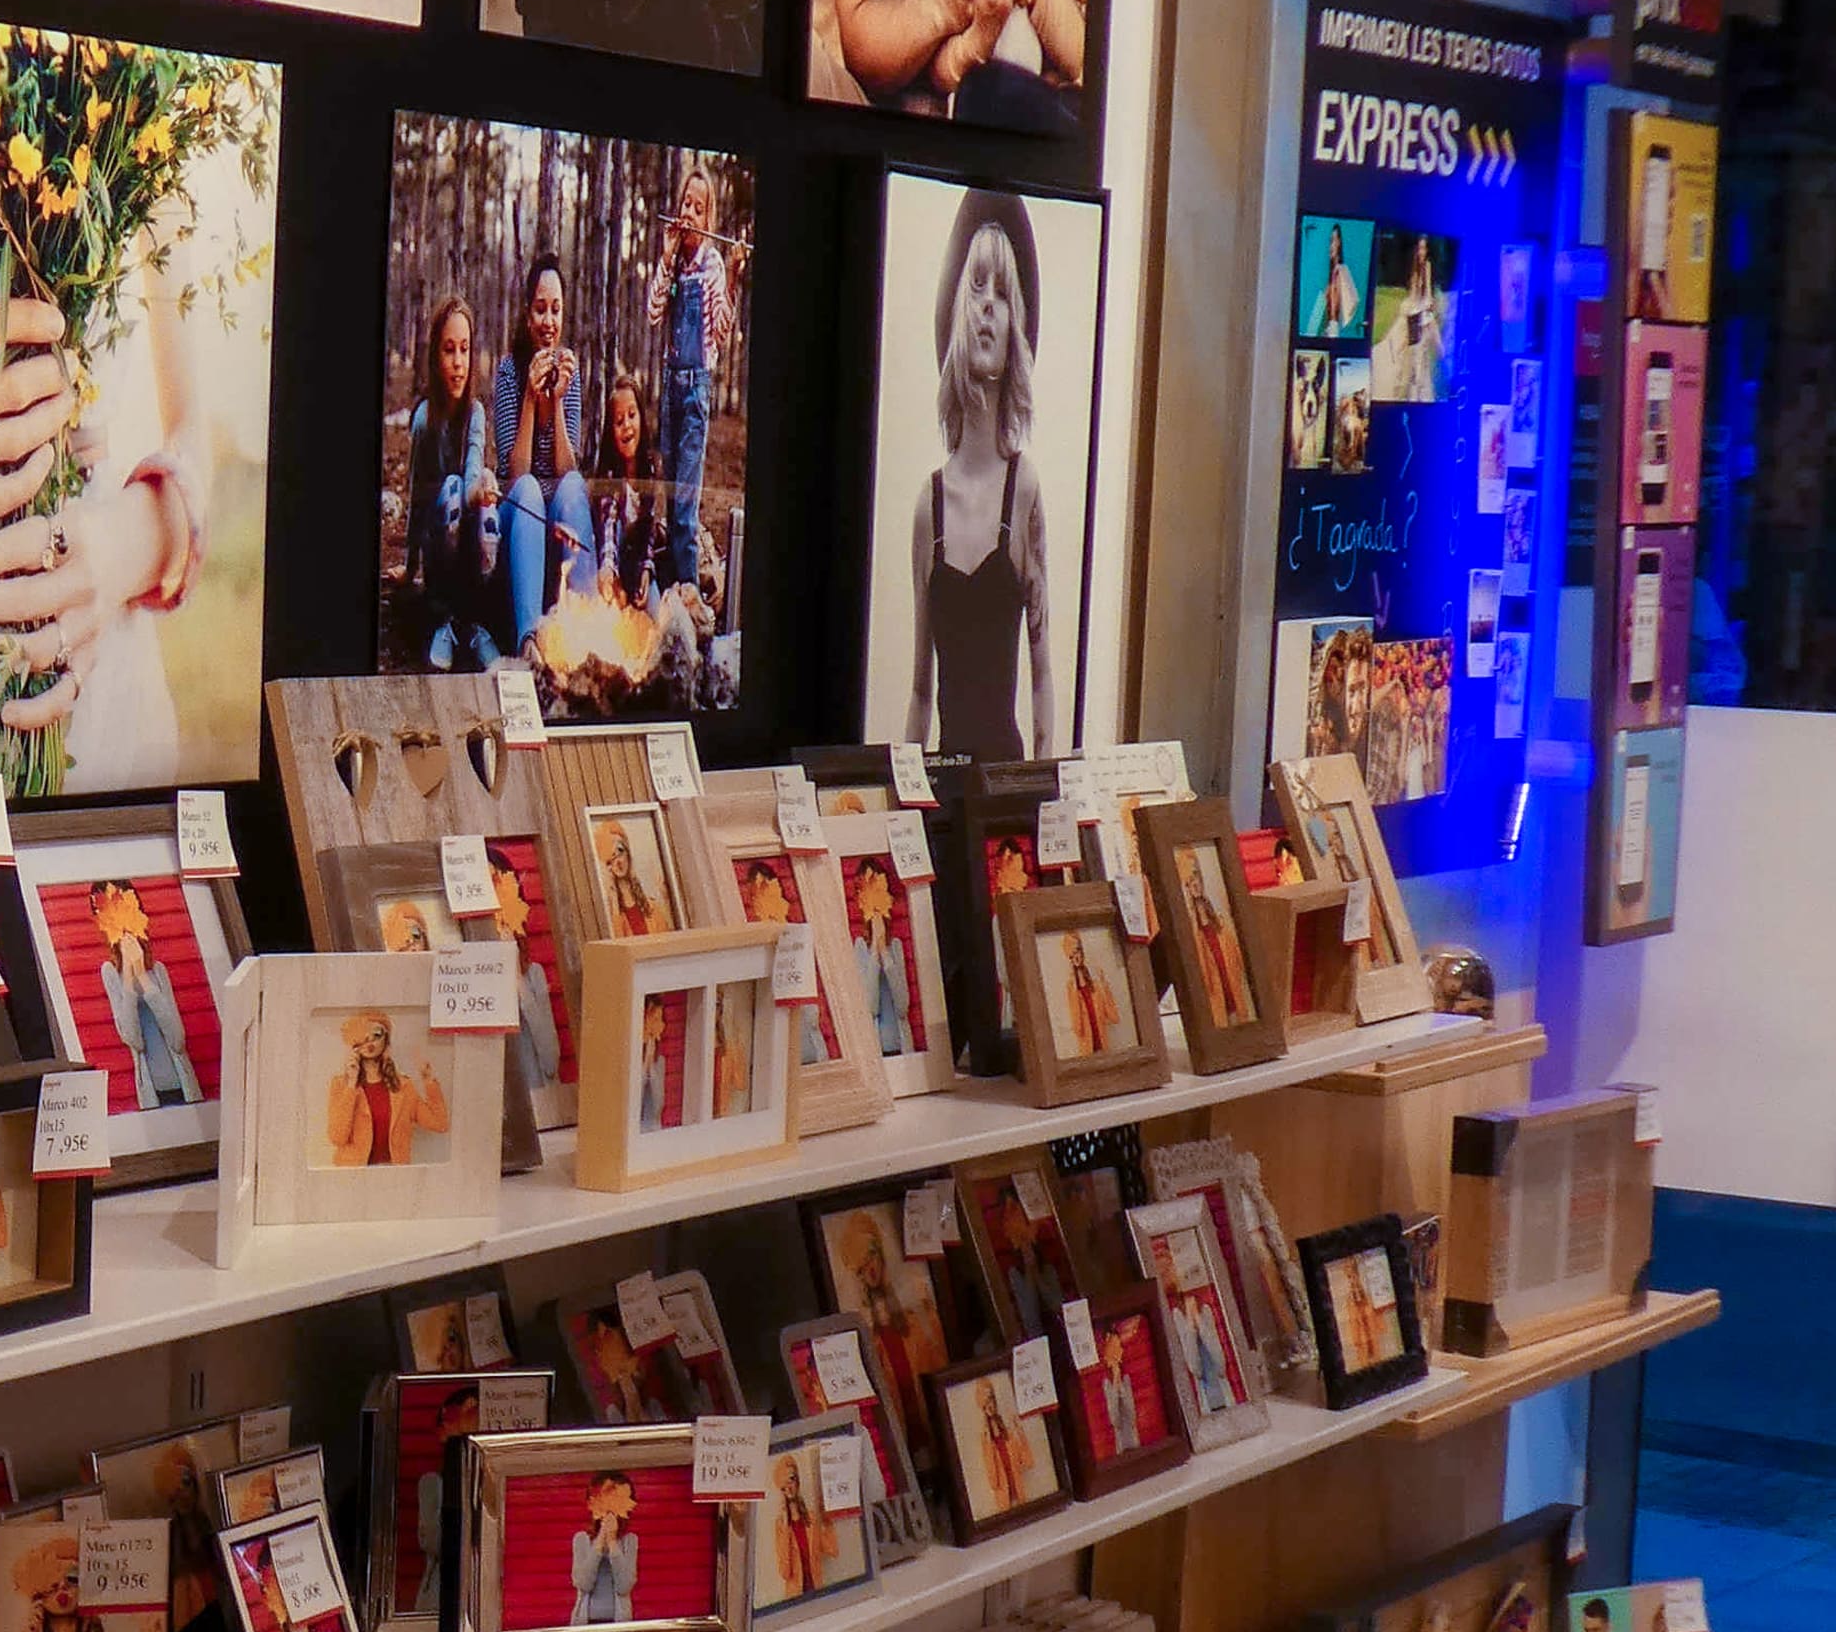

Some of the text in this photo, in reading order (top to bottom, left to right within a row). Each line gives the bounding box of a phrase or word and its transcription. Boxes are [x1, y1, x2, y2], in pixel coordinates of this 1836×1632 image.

[1320, 7, 1542, 82] IMPRIMEIX LES TEVES FOTOS
[1313, 88, 1462, 178] EXPRESS
[438, 965, 472, 976] Marco
[41, 1095, 88, 1111] Marco 402
[86, 1541, 116, 1552] Marc
